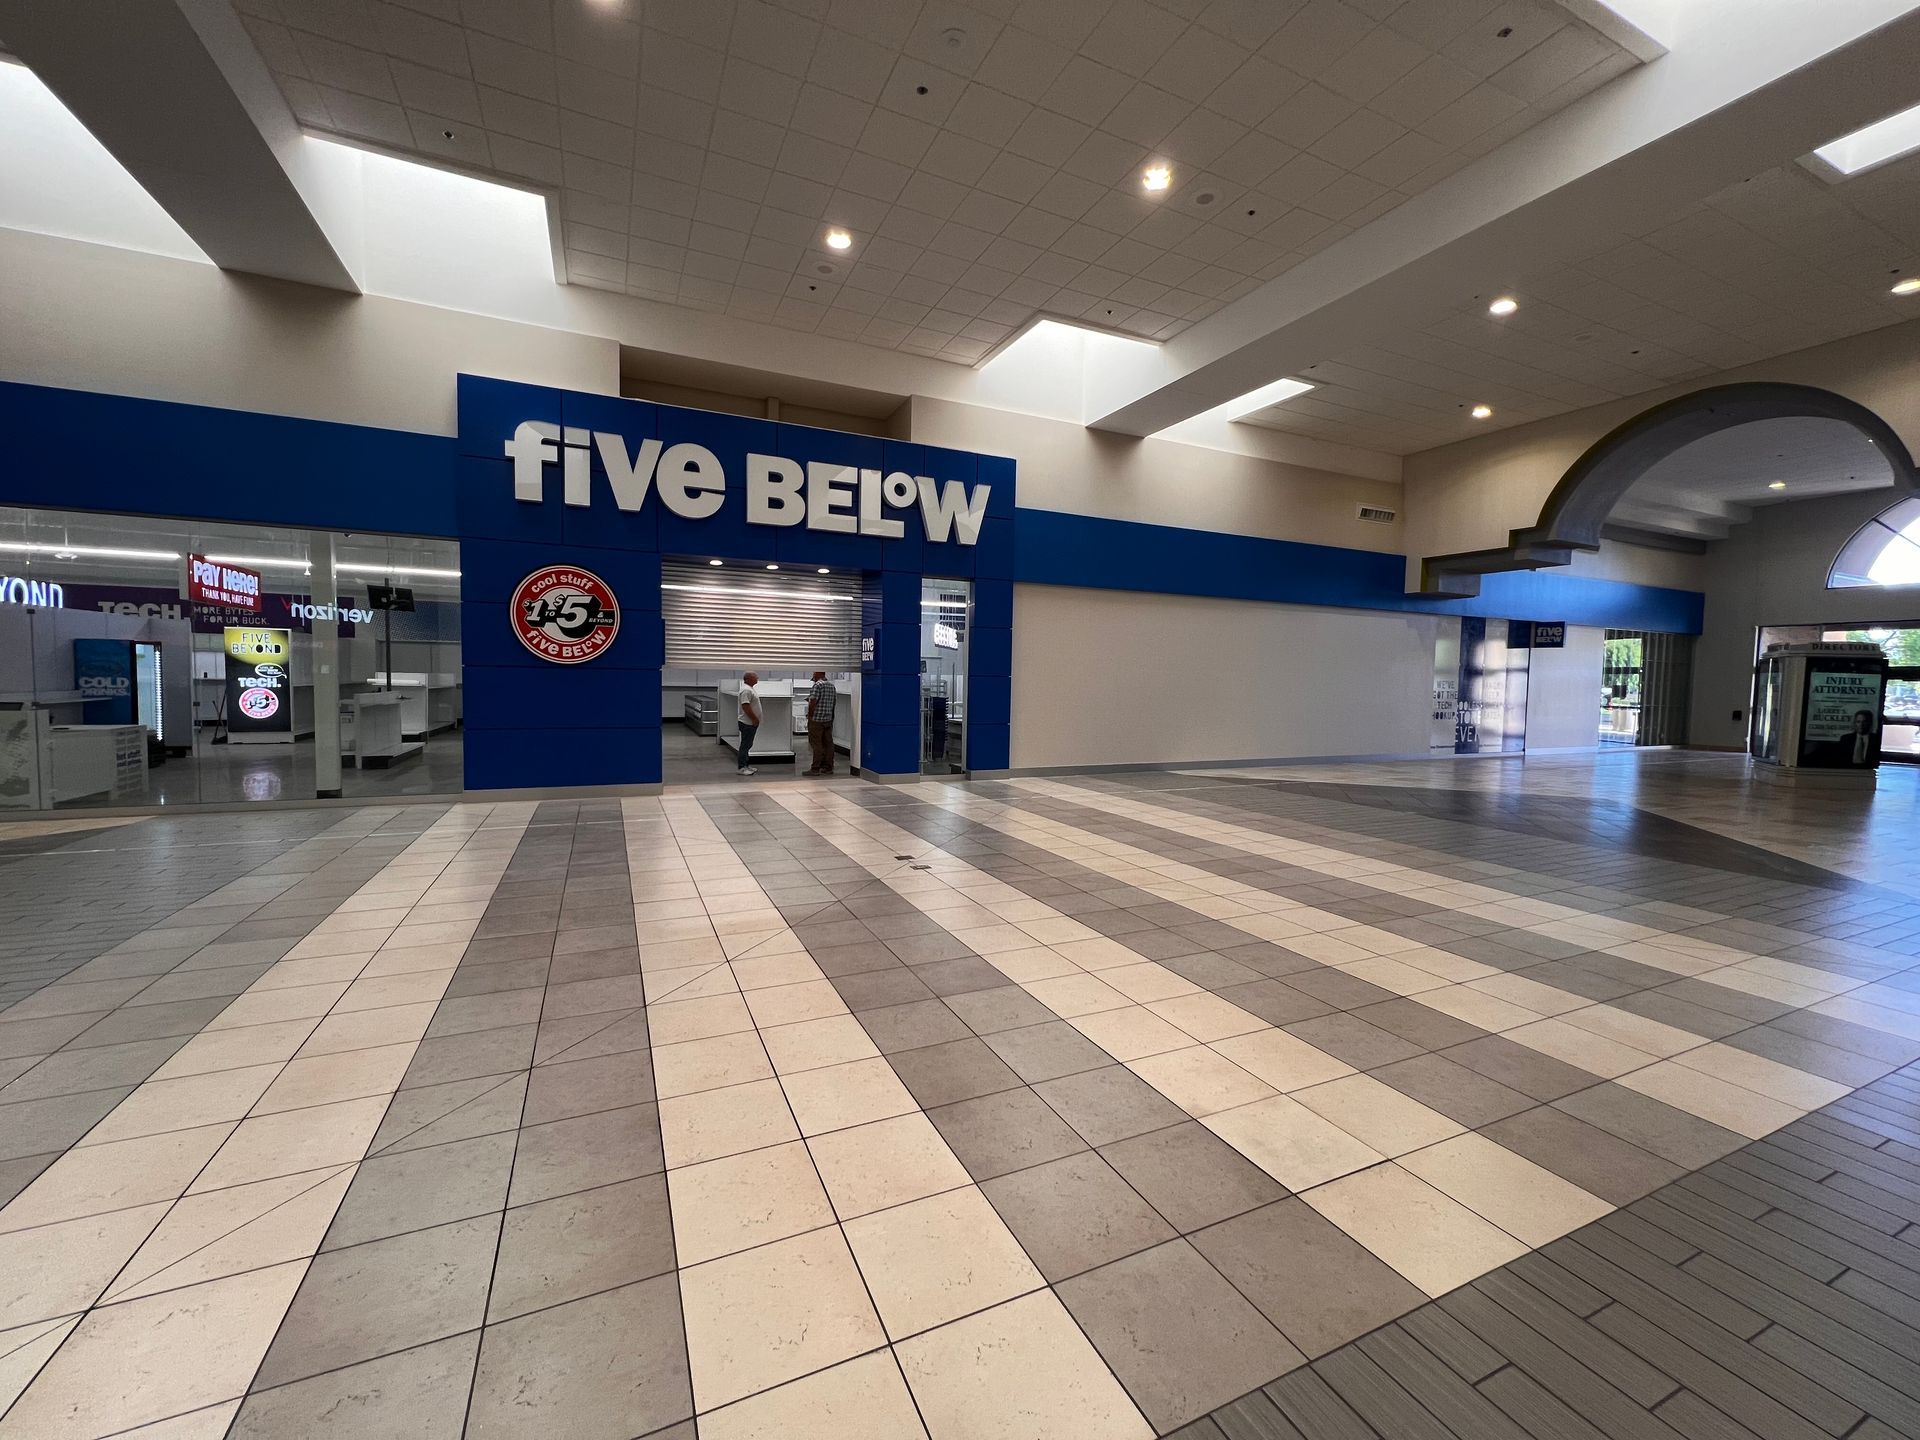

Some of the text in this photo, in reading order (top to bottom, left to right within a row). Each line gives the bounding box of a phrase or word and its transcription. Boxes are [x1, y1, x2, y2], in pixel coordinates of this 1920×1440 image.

[531, 573, 594, 592] cool stuff
[202, 588, 219, 600] THANK
[194, 606, 220, 615] MORE
[204, 616, 223, 624] FOR
[226, 616, 239, 624] UR
[242, 633, 270, 643] FIVE
[526, 630, 559, 655] five
[231, 644, 282, 654] BEYOND
[1811, 642, 1877, 651] DIRECTORY
[78, 676, 130, 688] COLD
[1826, 677, 1864, 686] INJURY
[1812, 685, 1877, 696] ATTORNEYS
[1813, 713, 1853, 722] BUCKLEY
